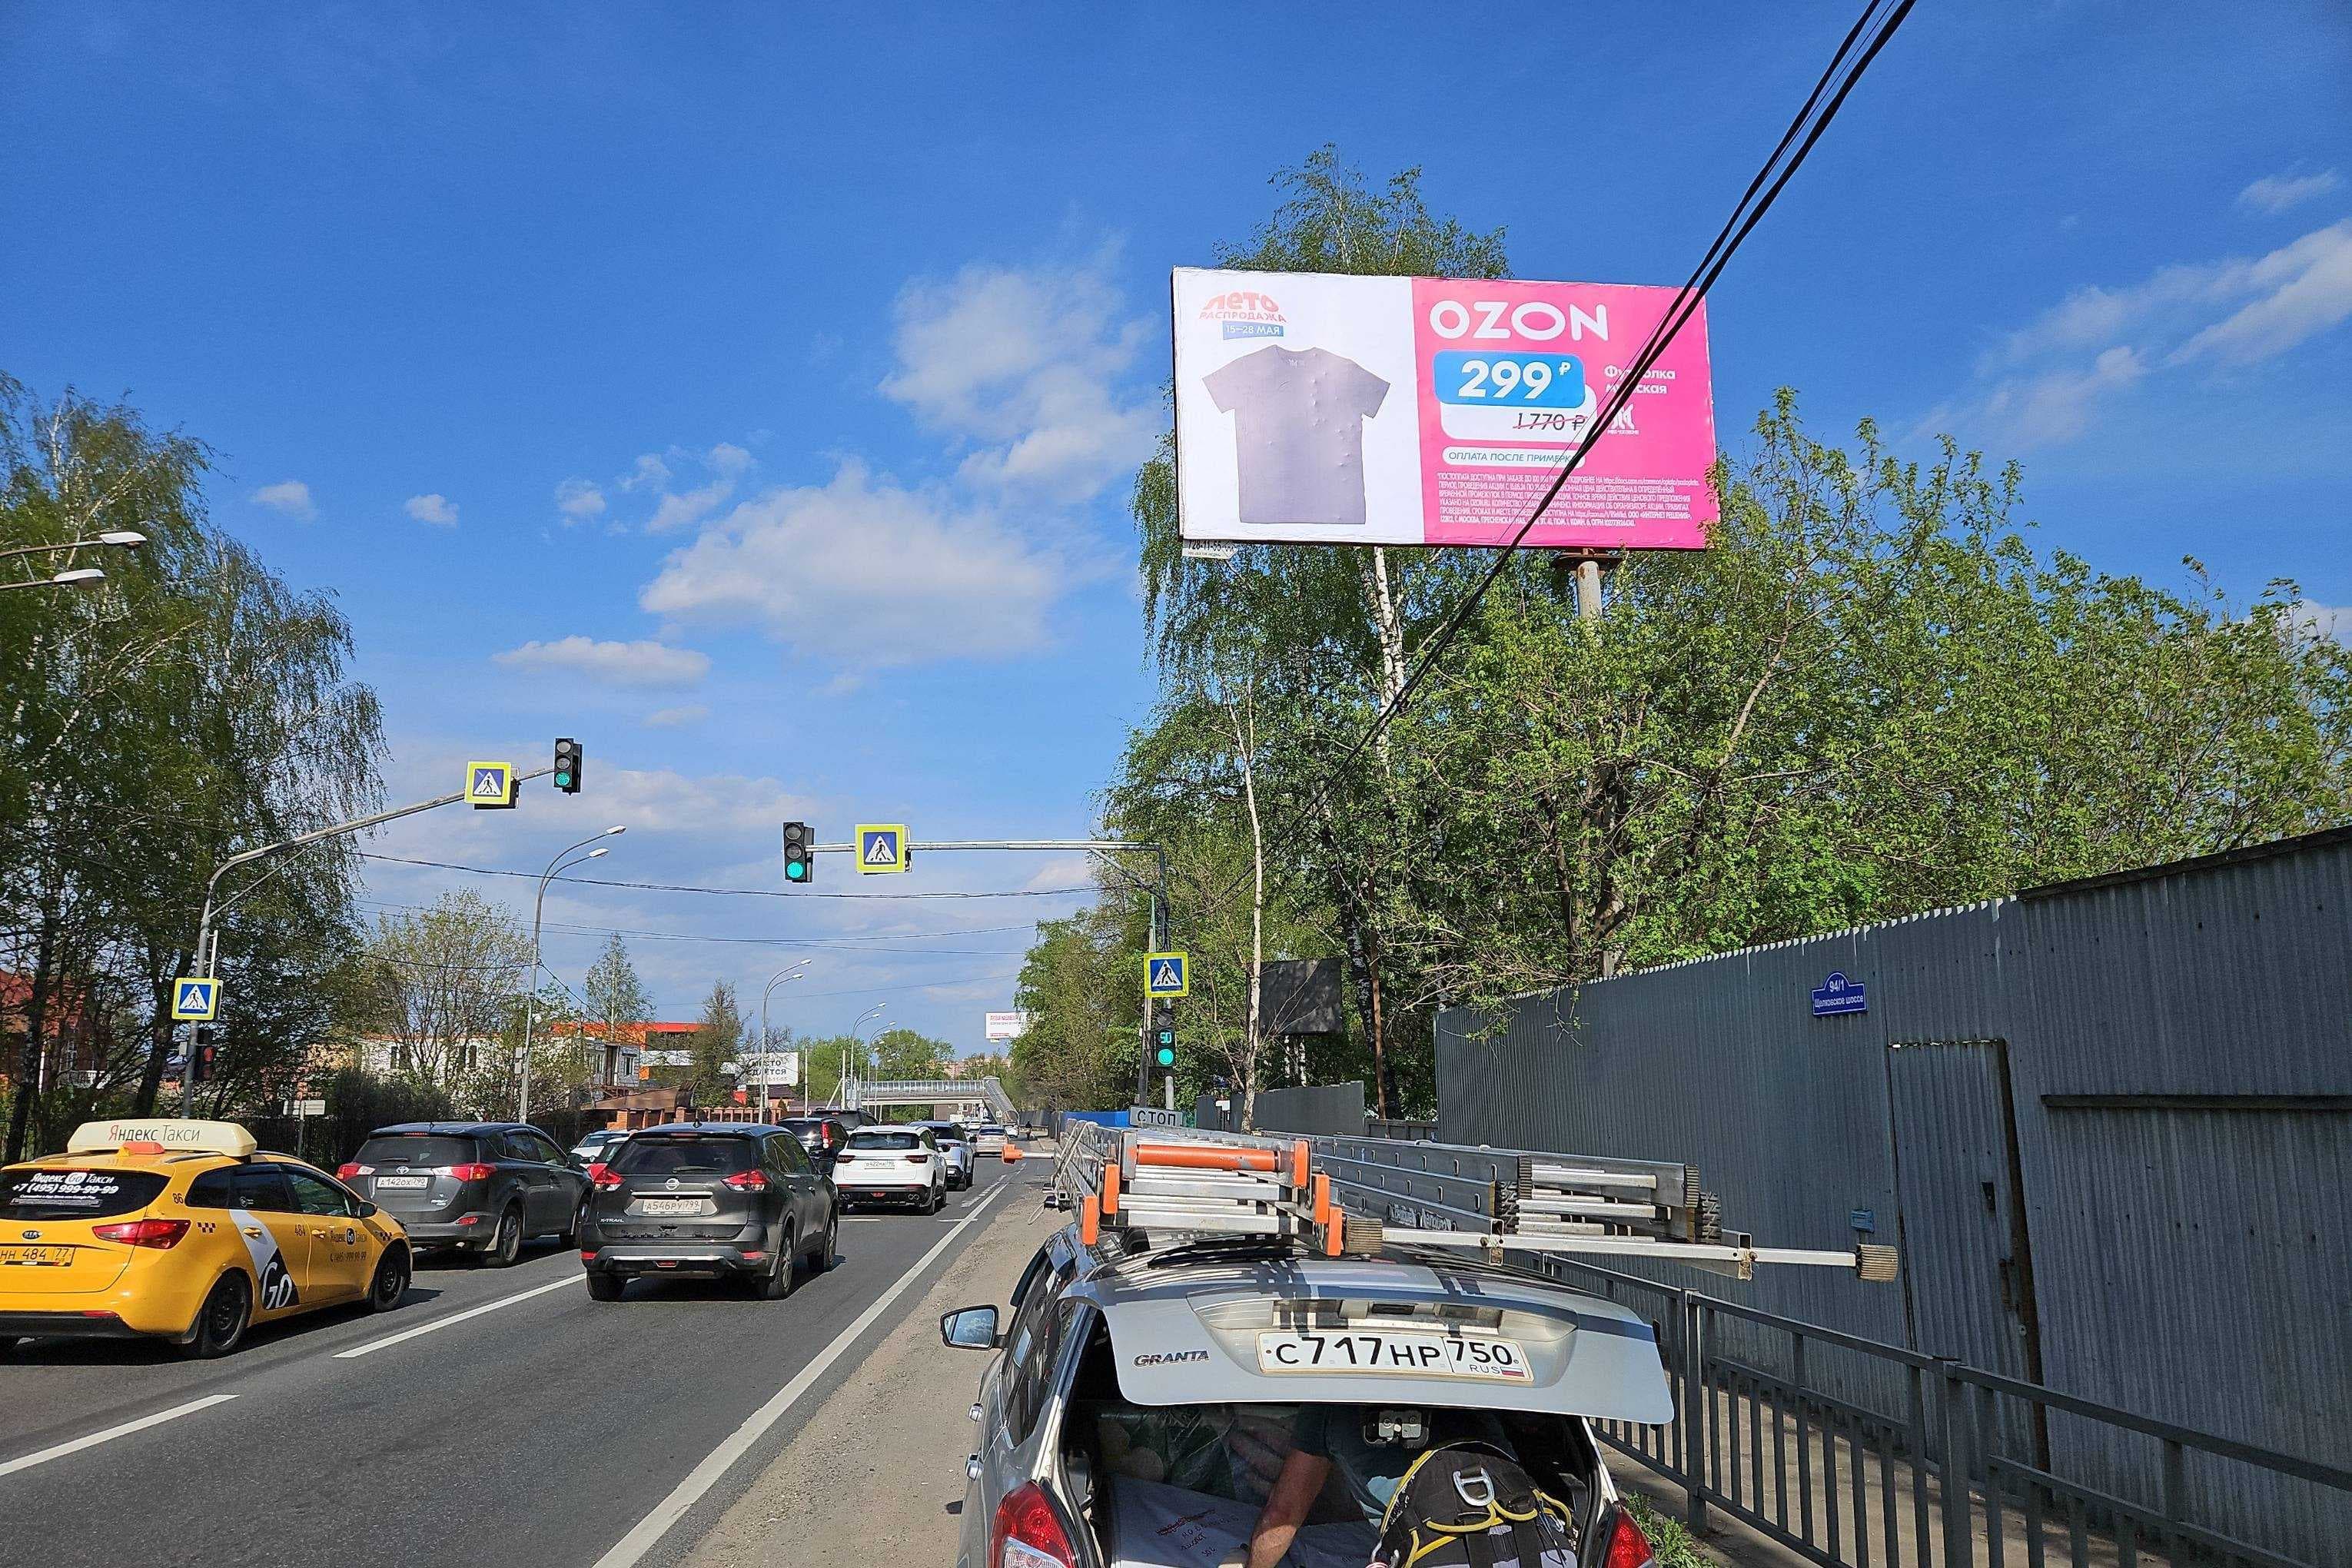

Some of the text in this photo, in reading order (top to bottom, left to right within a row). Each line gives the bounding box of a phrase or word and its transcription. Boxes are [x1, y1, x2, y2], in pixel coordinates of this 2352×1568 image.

[1198, 311, 1287, 324] РАСПРОДАЖА
[1429, 300, 1609, 341] OZON
[1256, 326, 1281, 335] МАЯ
[1458, 360, 1553, 400] 299
[1605, 384, 1667, 394] мская
[1448, 452, 1573, 463] ОПЛАТА ПОСЛЕ ПРИМЕРК
[1829, 978, 1845, 992] 94/1
[1845, 995, 1864, 1005] шоссе
[1138, 1110, 1176, 1127] СТОП
[108, 1125, 200, 1142] Яндекс Такси
[30, 1172, 67, 1184] Яндекс
[86, 1173, 115, 1184] Такси
[12, 1183, 119, 1194] +7 (495) 999-99-99
[172, 1193, 184, 1204] 86
[294, 1224, 306, 1237] 484
[22, 1248, 47, 1261] 484
[55, 1248, 69, 1258] 77
[261, 1262, 293, 1310] Go
[1133, 1350, 1210, 1367] GRANTA
[1275, 1337, 1513, 1368] С717НР 750
[1469, 1364, 1500, 1374] RUS
